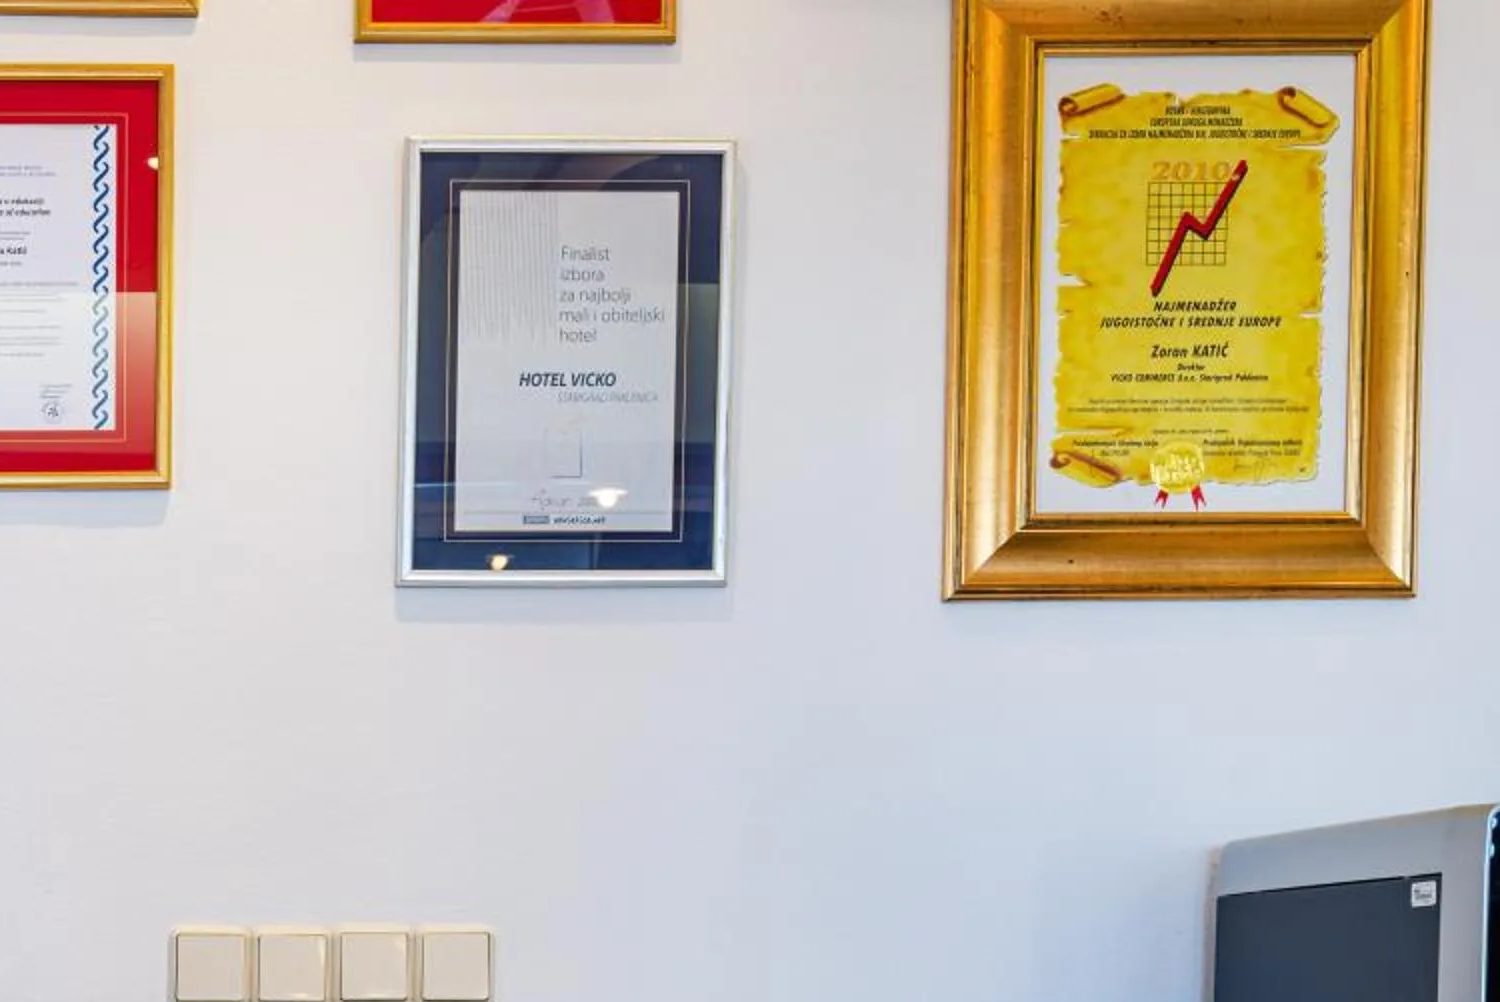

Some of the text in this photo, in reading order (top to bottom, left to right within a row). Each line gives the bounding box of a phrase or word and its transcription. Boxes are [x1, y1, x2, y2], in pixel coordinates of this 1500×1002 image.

[1153, 161, 1232, 181] 2010
[560, 246, 610, 262] Finalist
[560, 268, 606, 282] izbora
[560, 288, 632, 306] za najbolji
[1153, 298, 1237, 312] NAJMENADŽER
[559, 309, 590, 323] mali
[601, 308, 666, 327] obiteljski
[1100, 314, 1176, 329] JUGOISTOČNE
[1187, 316, 1235, 328] SREDNJE
[1238, 316, 1283, 328] EUROPE
[559, 328, 598, 343] hotel
[1151, 341, 1230, 358] Zoran KATIĆ
[519, 371, 617, 388] HOTEL VICKO
